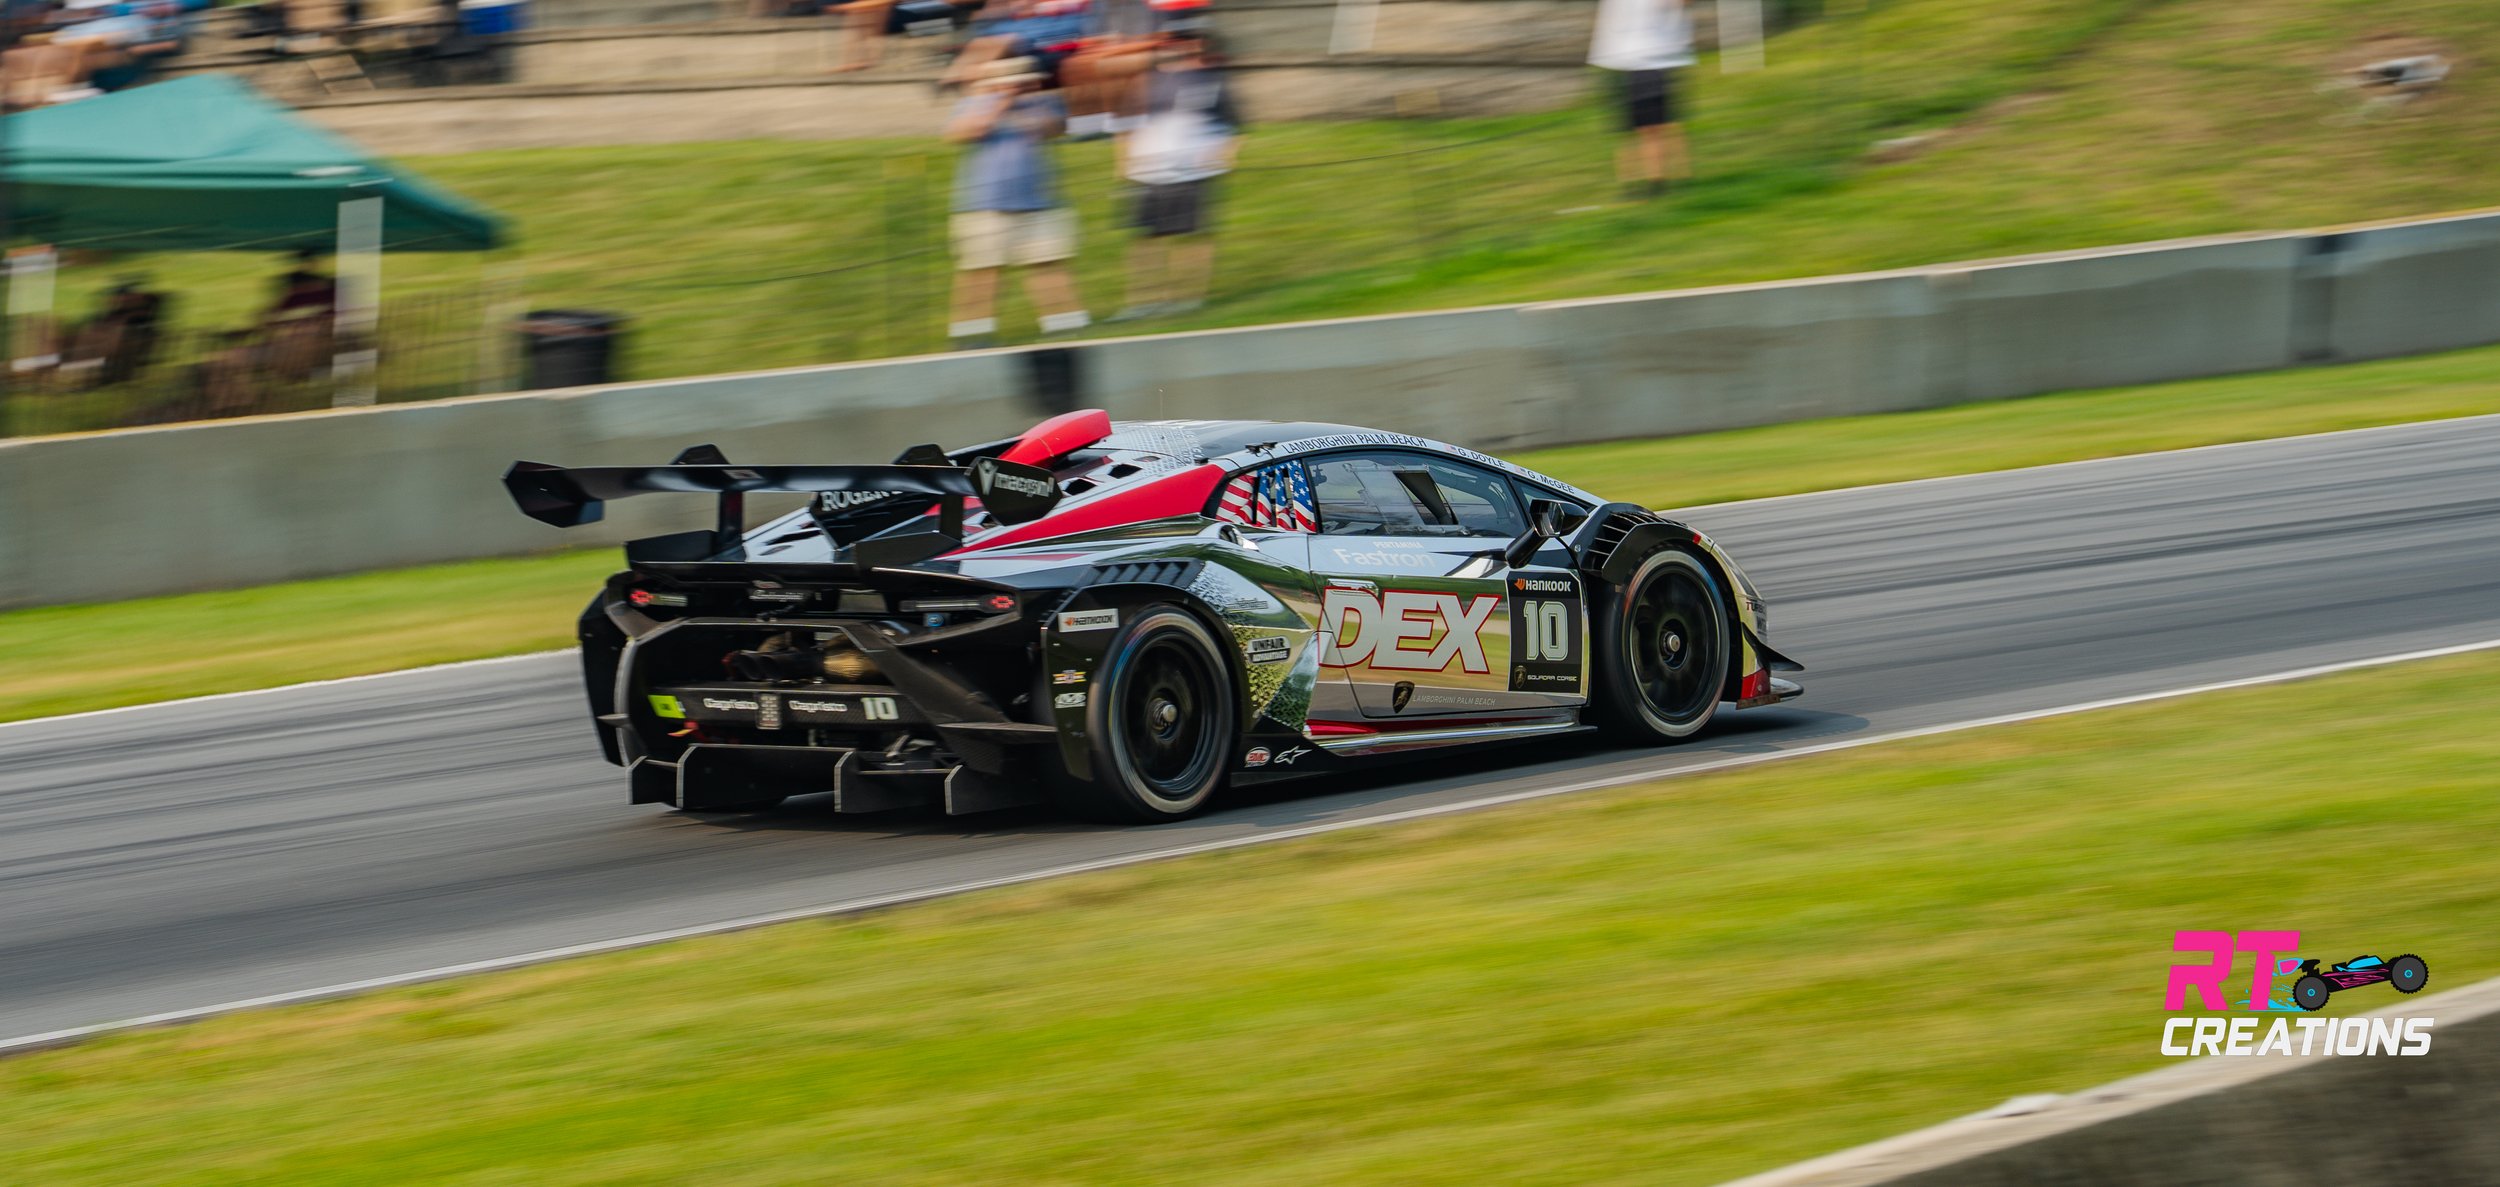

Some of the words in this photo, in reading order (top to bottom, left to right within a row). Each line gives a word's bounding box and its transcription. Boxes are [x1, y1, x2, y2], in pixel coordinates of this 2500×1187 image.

[1281, 434, 1358, 454] LAMBORGHINI
[1359, 433, 1389, 445] PALM
[1388, 434, 1428, 448] BEACH
[1458, 448, 1470, 459] G.
[1471, 451, 1506, 469] DOYLE
[1527, 470, 1539, 481] G.
[1540, 474, 1575, 494] McGEE
[1333, 548, 1437, 569] Fastron
[1318, 586, 1503, 675] DEX
[1523, 600, 1568, 662] 10
[860, 697, 899, 720] 10
[1412, 694, 1456, 704] LAMBORGHINI
[1456, 696, 1475, 705] PALM
[1474, 697, 1497, 706] BEACH
